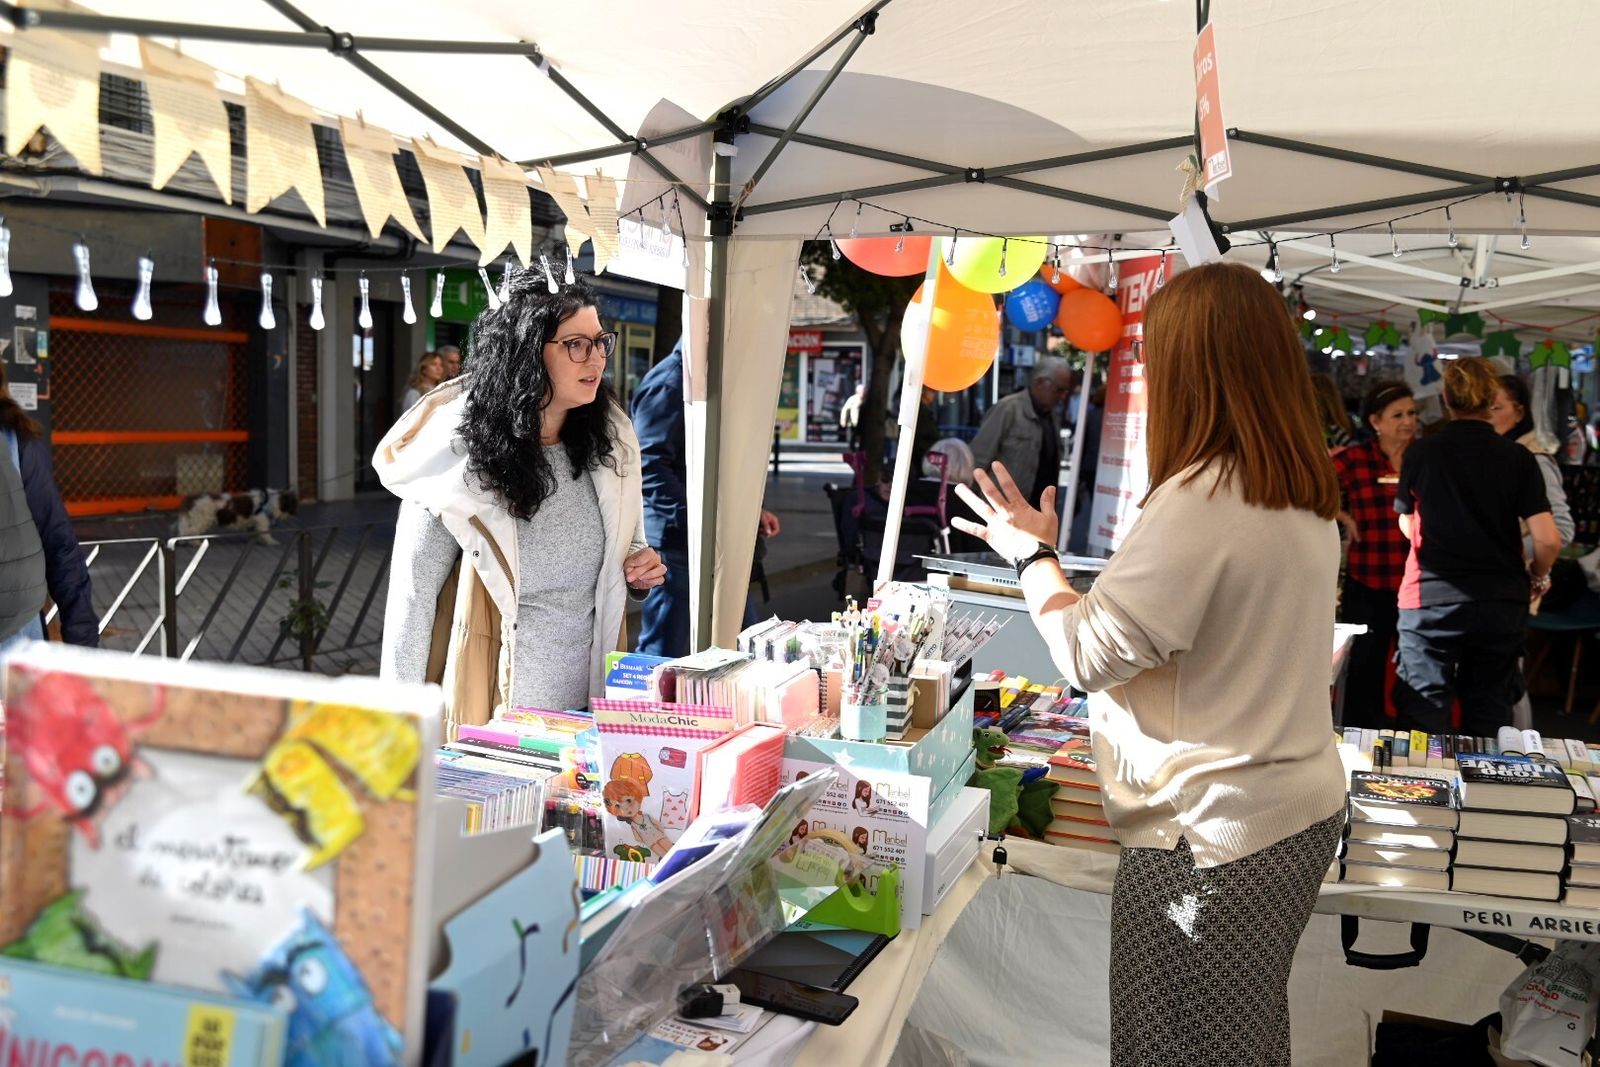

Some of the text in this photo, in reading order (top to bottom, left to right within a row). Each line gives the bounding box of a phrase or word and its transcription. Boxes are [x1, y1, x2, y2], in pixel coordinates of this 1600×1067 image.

[925, 643, 937, 659] OTTO
[955, 654, 967, 666] OTTO
[629, 713, 699, 727] ModaChic
[872, 829, 908, 845] Maribel
[883, 846, 895, 854] 552
[895, 847, 906, 855] 401
[1463, 910, 1600, 935] PERI ARRIE
